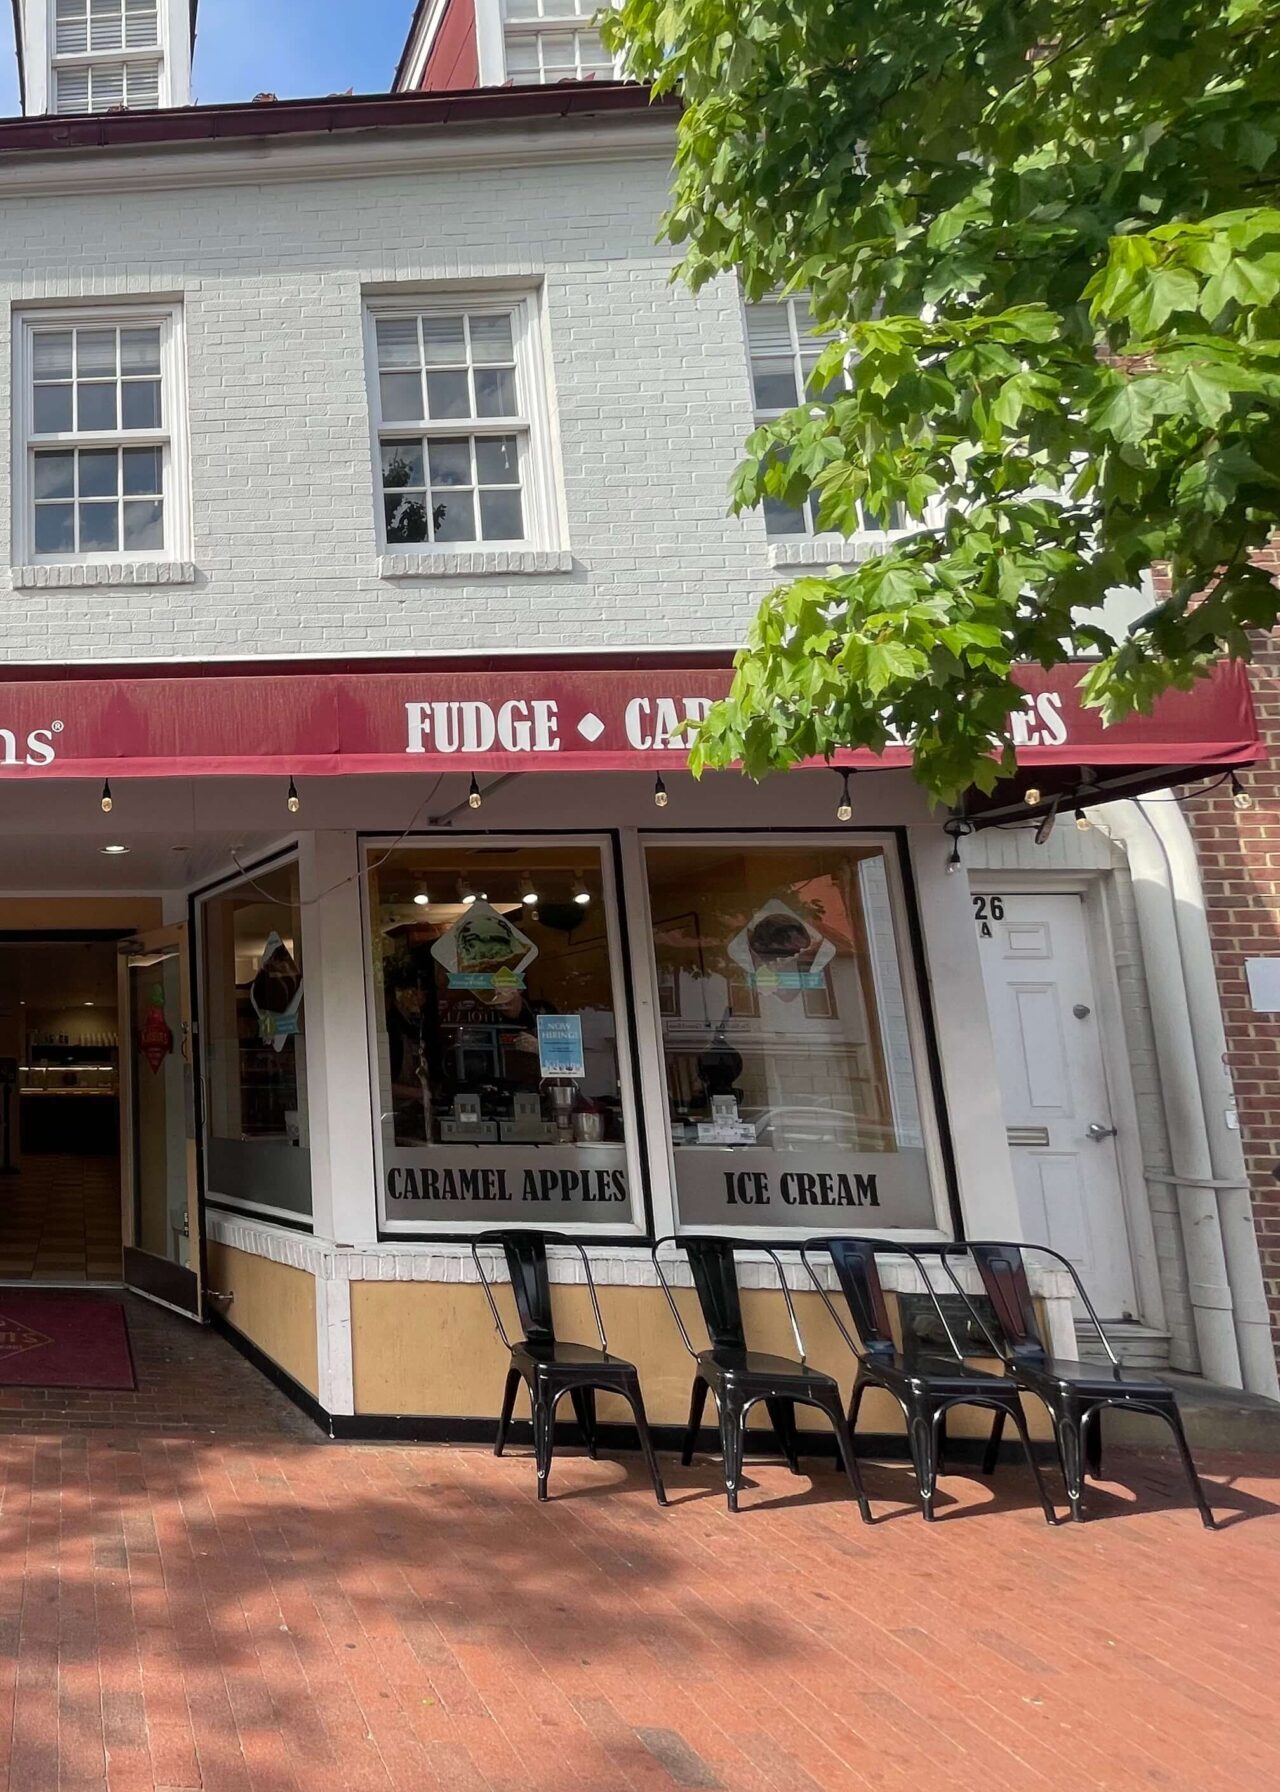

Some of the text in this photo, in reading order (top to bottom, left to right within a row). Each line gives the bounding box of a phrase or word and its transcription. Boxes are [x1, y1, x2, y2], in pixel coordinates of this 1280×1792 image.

[404, 699, 561, 753] FUDGE
[980, 921, 993, 938] A
[387, 1167, 627, 1202] CARAMEL APPLES
[723, 1171, 880, 1207] ICE CREAM
